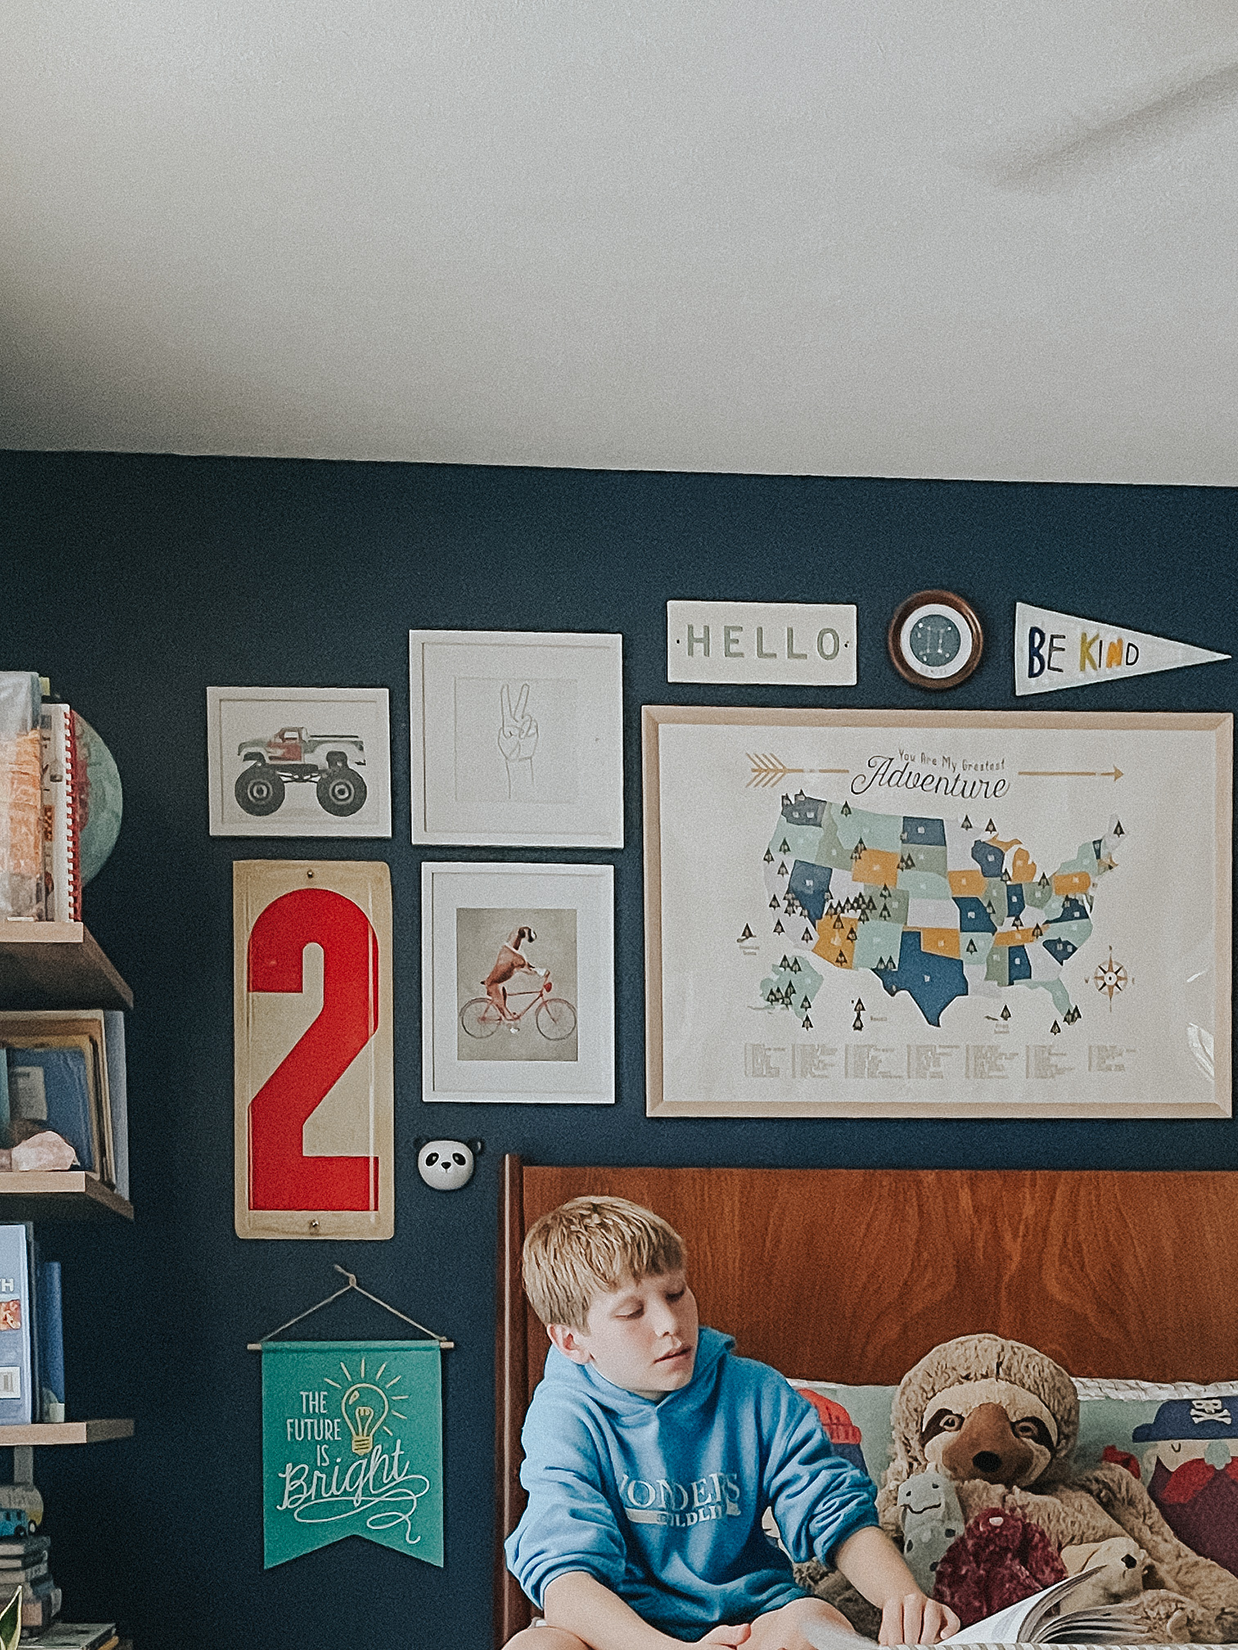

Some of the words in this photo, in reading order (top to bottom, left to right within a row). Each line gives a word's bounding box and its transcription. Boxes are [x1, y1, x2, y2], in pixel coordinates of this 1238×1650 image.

[687, 624, 840, 661] HELLO
[1028, 626, 1066, 679] BE
[1080, 632, 1140, 672] KIND
[850, 755, 1010, 799] Adventure
[899, 748, 916, 763] You
[920, 752, 937, 766] Are
[941, 755, 957, 774] My
[962, 758, 1005, 773] Greatest
[247, 888, 379, 1211] 2
[300, 1391, 329, 1414] THE
[286, 1418, 342, 1441] FUTURE
[317, 1444, 330, 1467] IS
[276, 1439, 412, 1511] Bright
